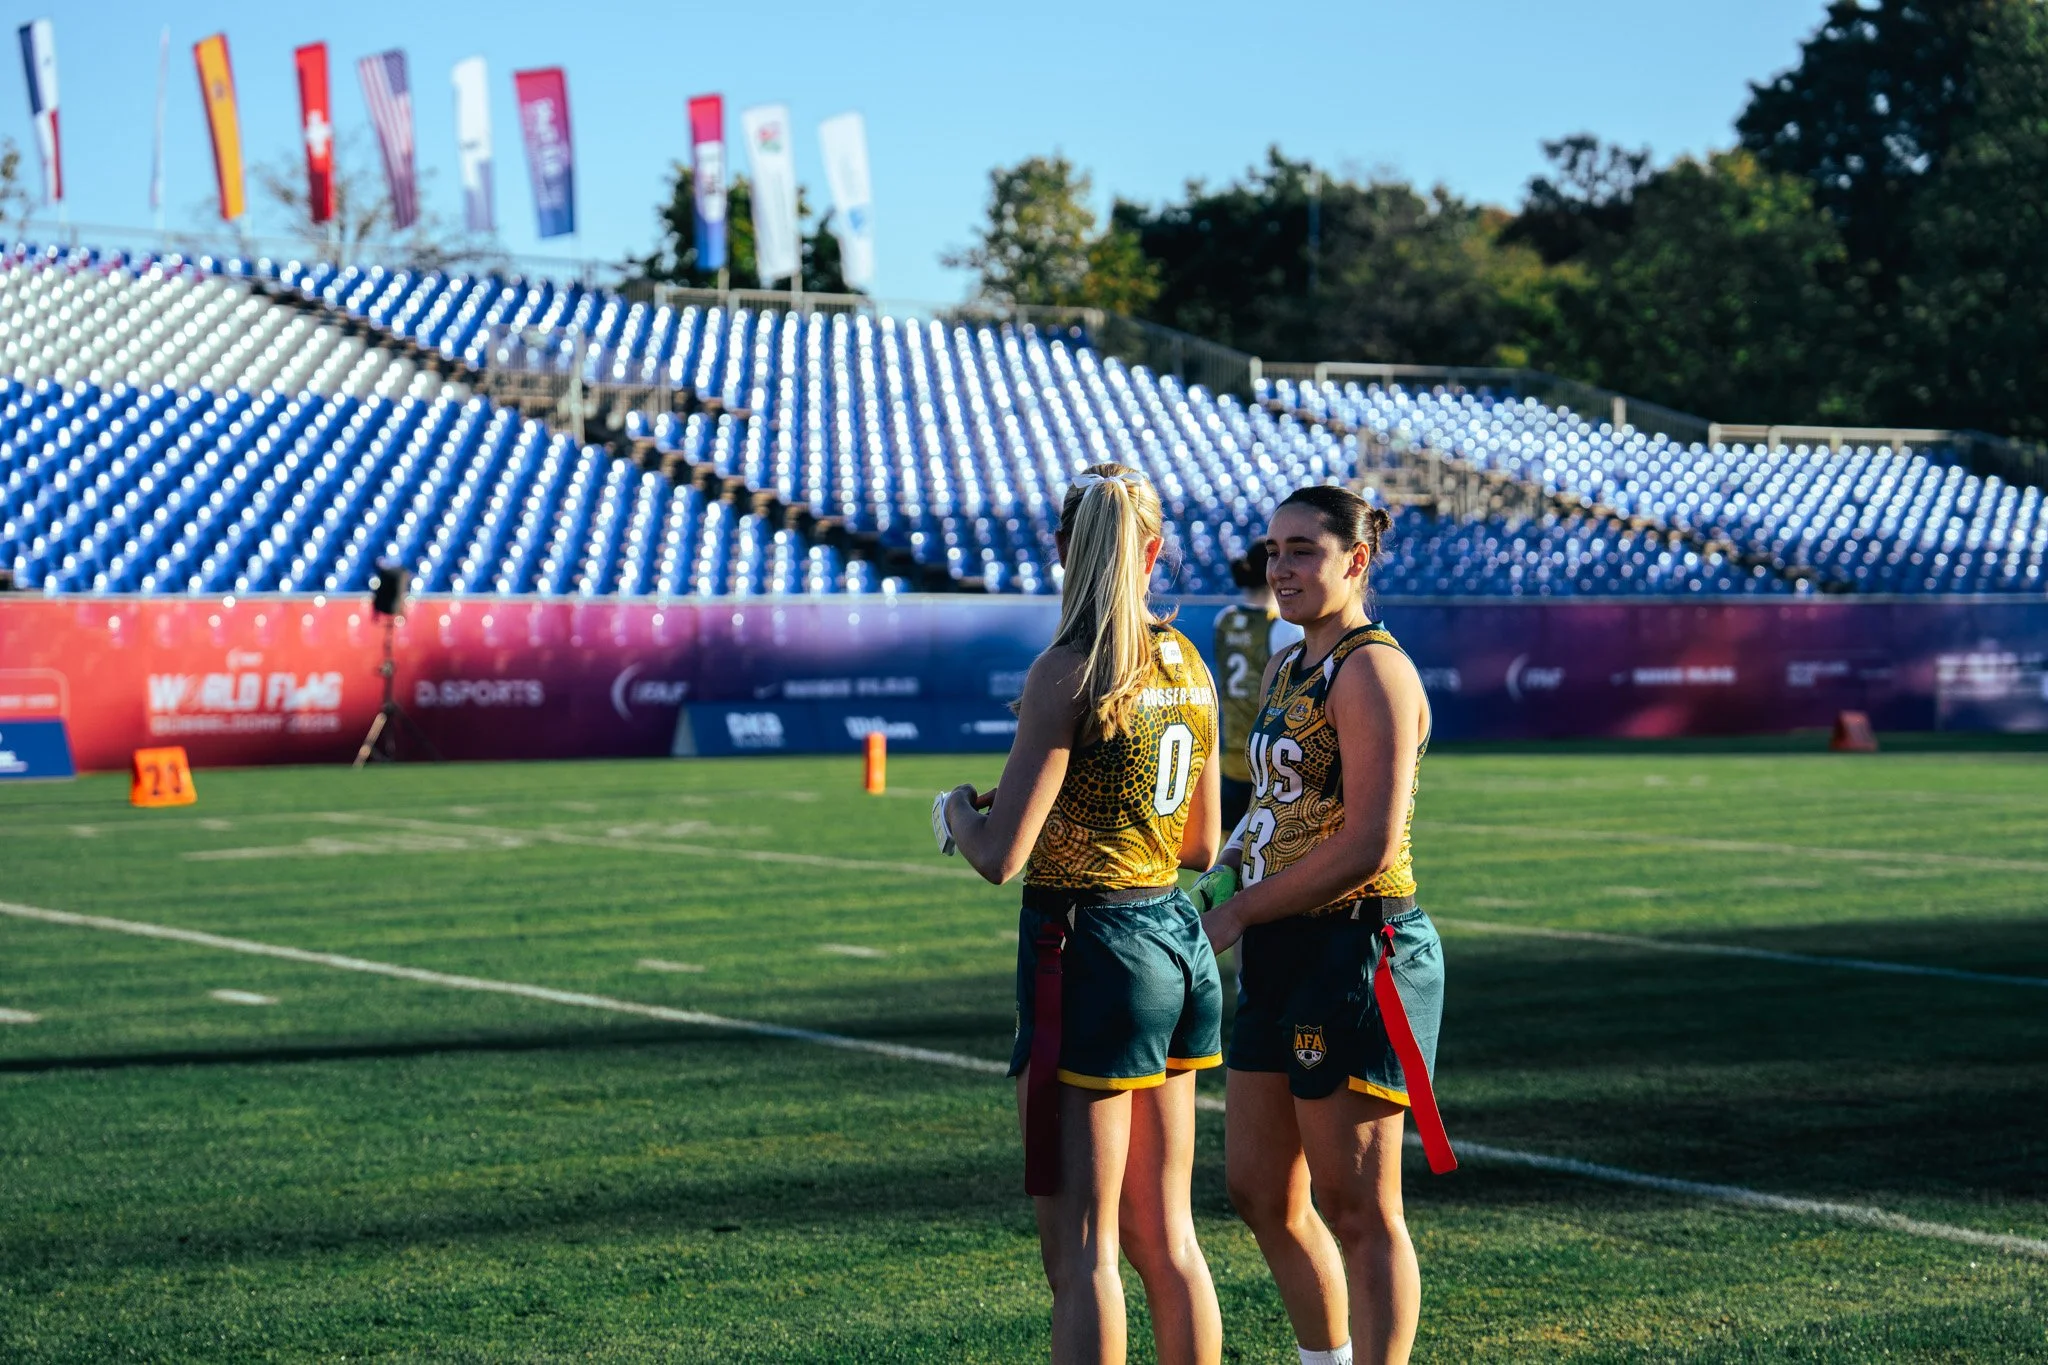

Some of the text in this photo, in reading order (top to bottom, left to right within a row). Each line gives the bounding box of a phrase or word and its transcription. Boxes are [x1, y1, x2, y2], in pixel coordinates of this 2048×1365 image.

[1227, 653, 1249, 698] 2
[1153, 724, 1194, 816] 0
[1242, 807, 1276, 890] 3
[1295, 1033, 1325, 1052] AFA
